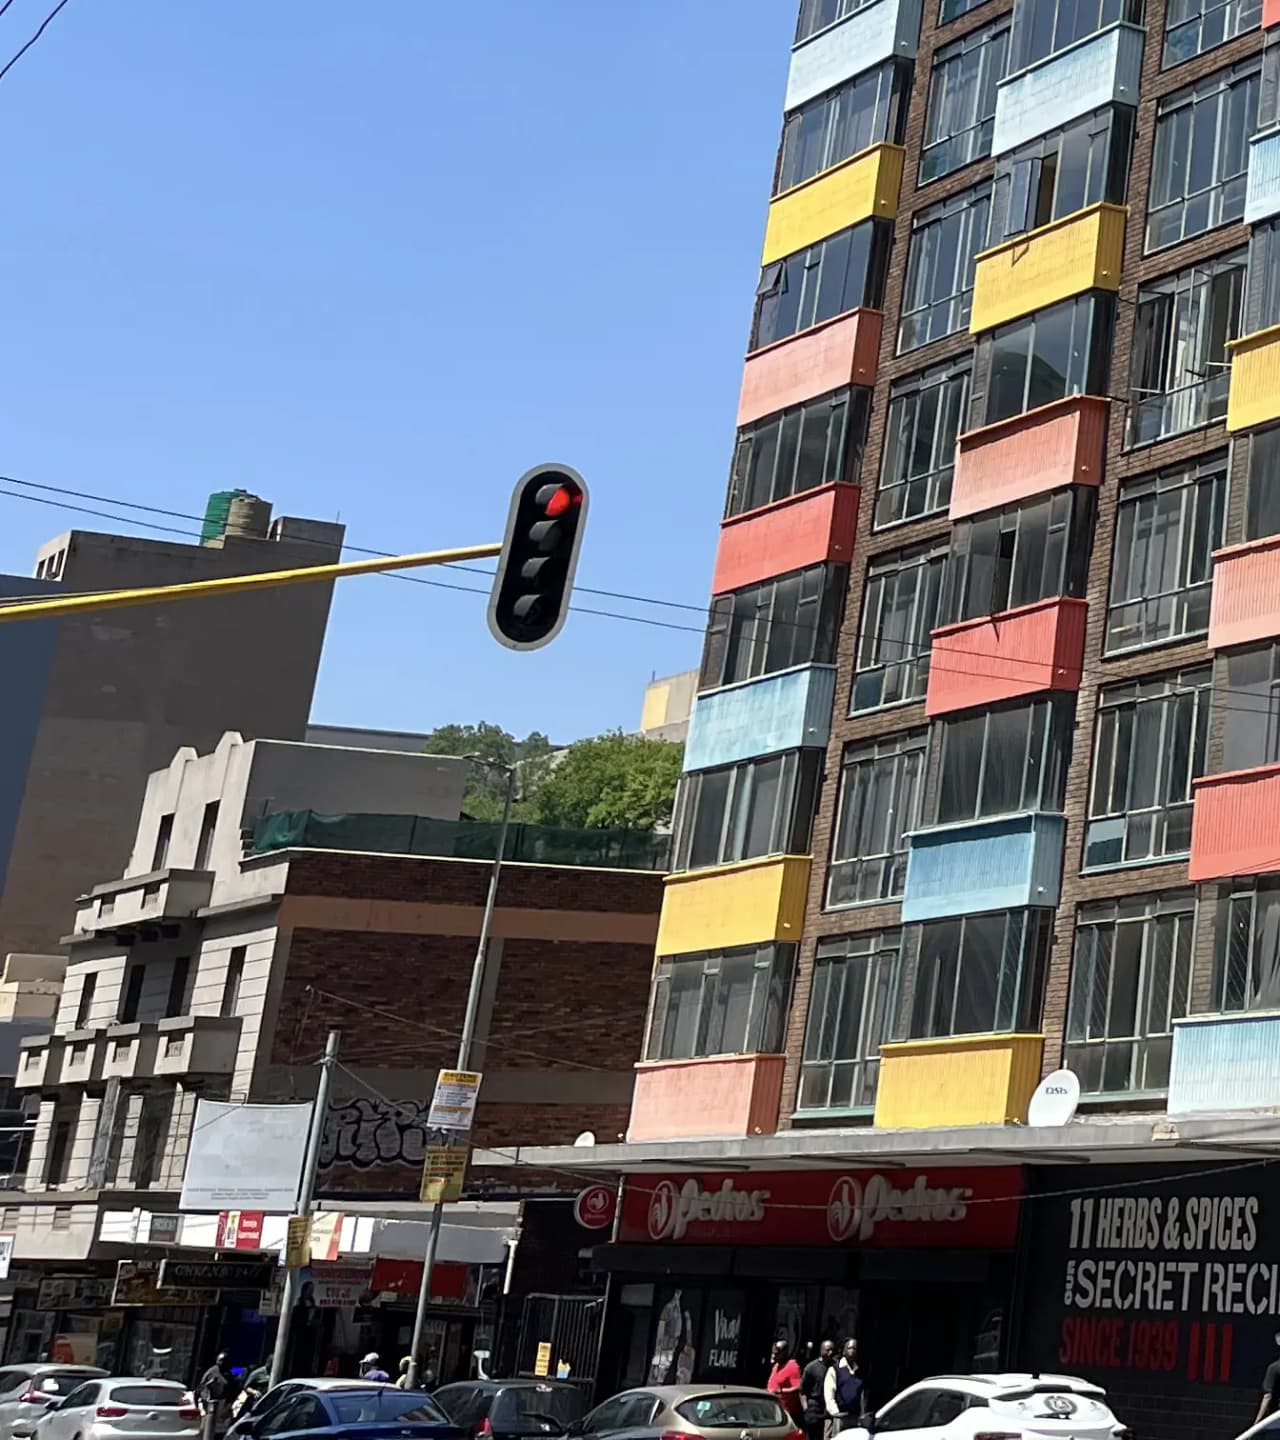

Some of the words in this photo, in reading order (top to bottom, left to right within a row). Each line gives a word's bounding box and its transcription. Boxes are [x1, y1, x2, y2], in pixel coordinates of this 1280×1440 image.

[1069, 1197, 1094, 1249] 11
[1096, 1197, 1162, 1250] HERBS
[1163, 1196, 1181, 1250] &
[1183, 1196, 1259, 1251] SPICES
[1064, 1260, 1076, 1306] OUR
[1074, 1259, 1199, 1311] SECRET
[708, 1349, 738, 1368] FLAME
[1060, 1317, 1124, 1367] SINCE
[1127, 1319, 1179, 1371] 1939
